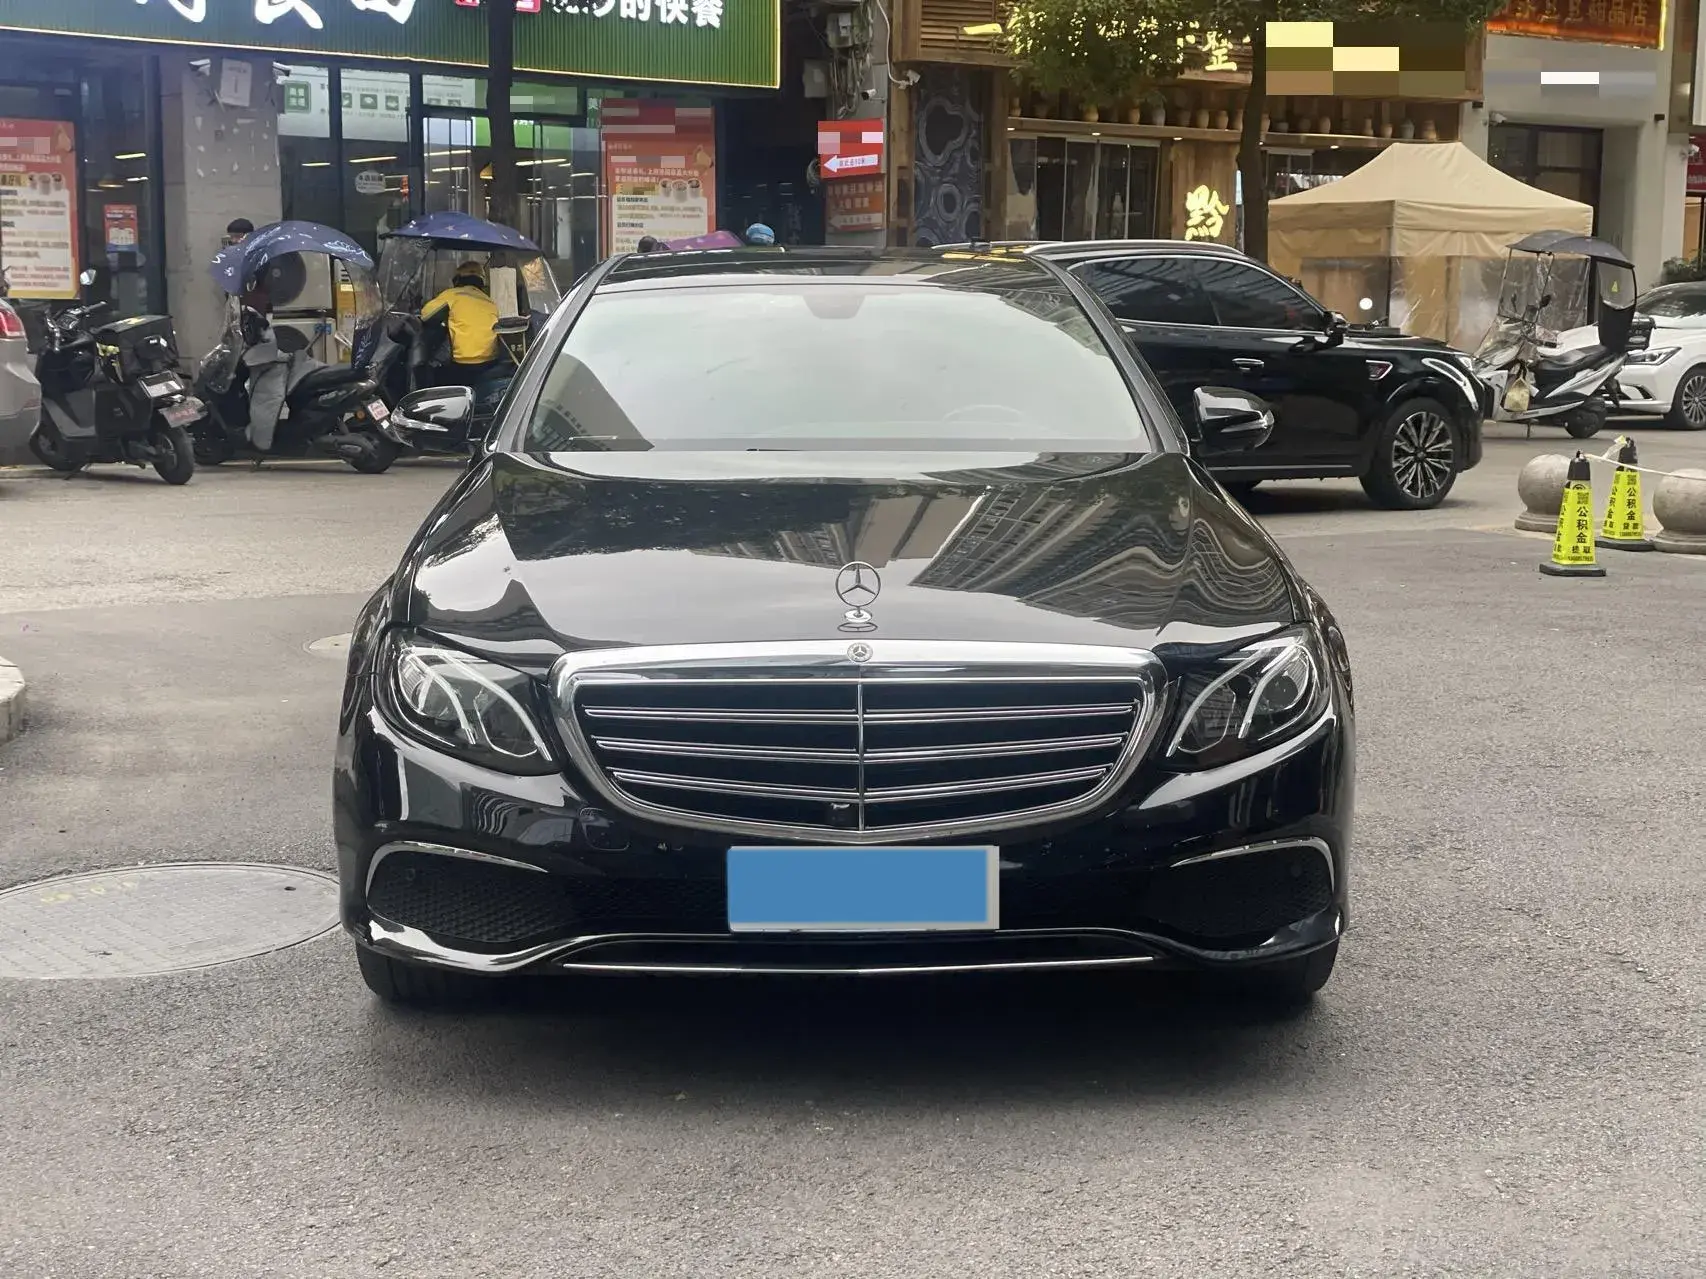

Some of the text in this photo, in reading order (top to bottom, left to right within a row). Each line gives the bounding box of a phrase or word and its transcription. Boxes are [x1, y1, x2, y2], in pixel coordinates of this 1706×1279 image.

[1626, 487, 1637, 521] 公积金
[1576, 506, 1588, 544] 公积金
